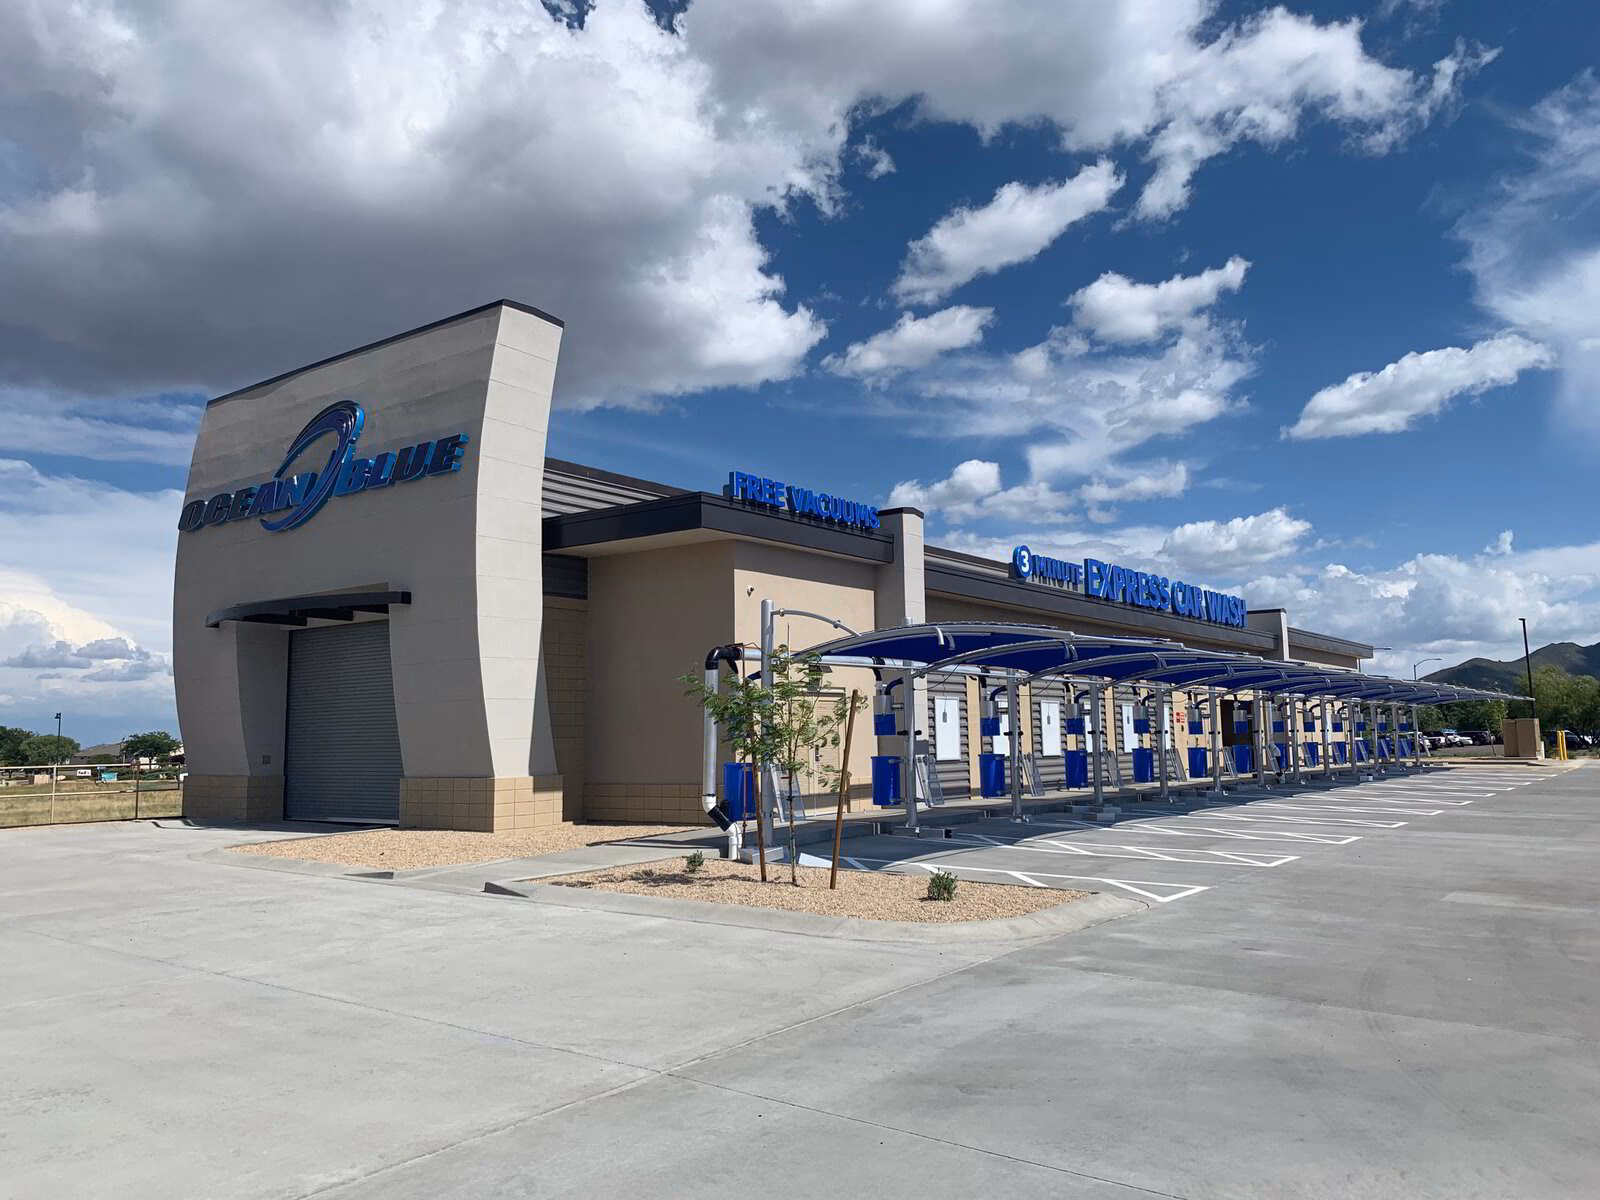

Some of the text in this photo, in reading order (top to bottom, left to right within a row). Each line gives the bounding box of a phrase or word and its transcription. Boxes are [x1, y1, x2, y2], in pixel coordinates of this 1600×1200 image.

[178, 433, 469, 531] OCEAN BLUE
[729, 471, 880, 529] FREE VACUUMS
[1020, 550, 1247, 628] 3 MINUTE EXPRESS CAR WASH
